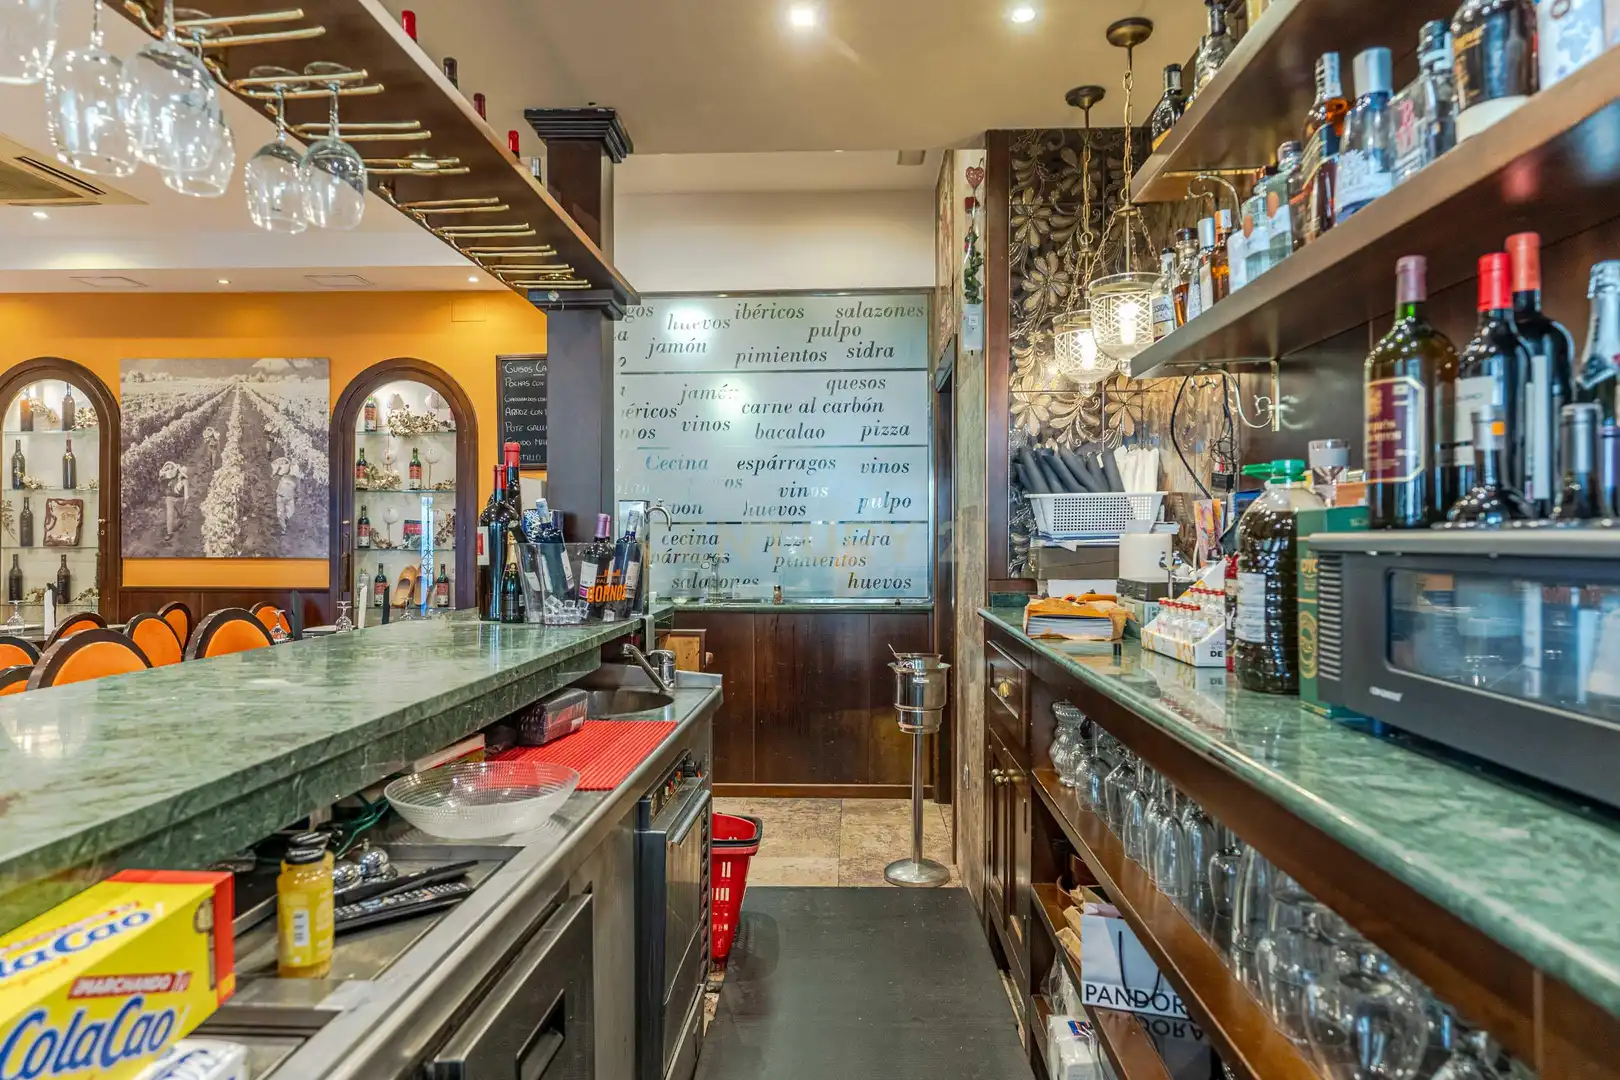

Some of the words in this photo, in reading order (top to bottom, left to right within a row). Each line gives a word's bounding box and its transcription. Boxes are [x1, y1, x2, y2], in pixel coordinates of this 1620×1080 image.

[735, 302, 805, 320] ibéricos
[835, 301, 925, 319] salazones
[667, 313, 731, 330] huevos
[807, 320, 862, 343] pulpo
[645, 337, 707, 359] jamón
[735, 346, 827, 368] pimientos
[846, 341, 895, 359] sidra
[826, 377, 887, 396] quesos
[741, 402, 793, 415] carne
[798, 397, 816, 414] al
[822, 396, 885, 414] carbón
[681, 414, 731, 432] vinos
[754, 422, 826, 440] bacalao
[861, 420, 911, 442] pizza
[645, 454, 709, 471] Cecina
[736, 455, 836, 476] espárragos
[860, 457, 910, 474] vinos
[743, 500, 807, 517] huevos
[857, 491, 912, 515] pulpo
[661, 528, 720, 546] cecina
[842, 529, 891, 547] sidra
[847, 572, 912, 590] huevos
[587, 584, 627, 603] BORNOS
[1210, 650, 1223, 658] DE
[1085, 983, 1189, 1017] PANDOR
[0, 995, 175, 1080] ColaCao
